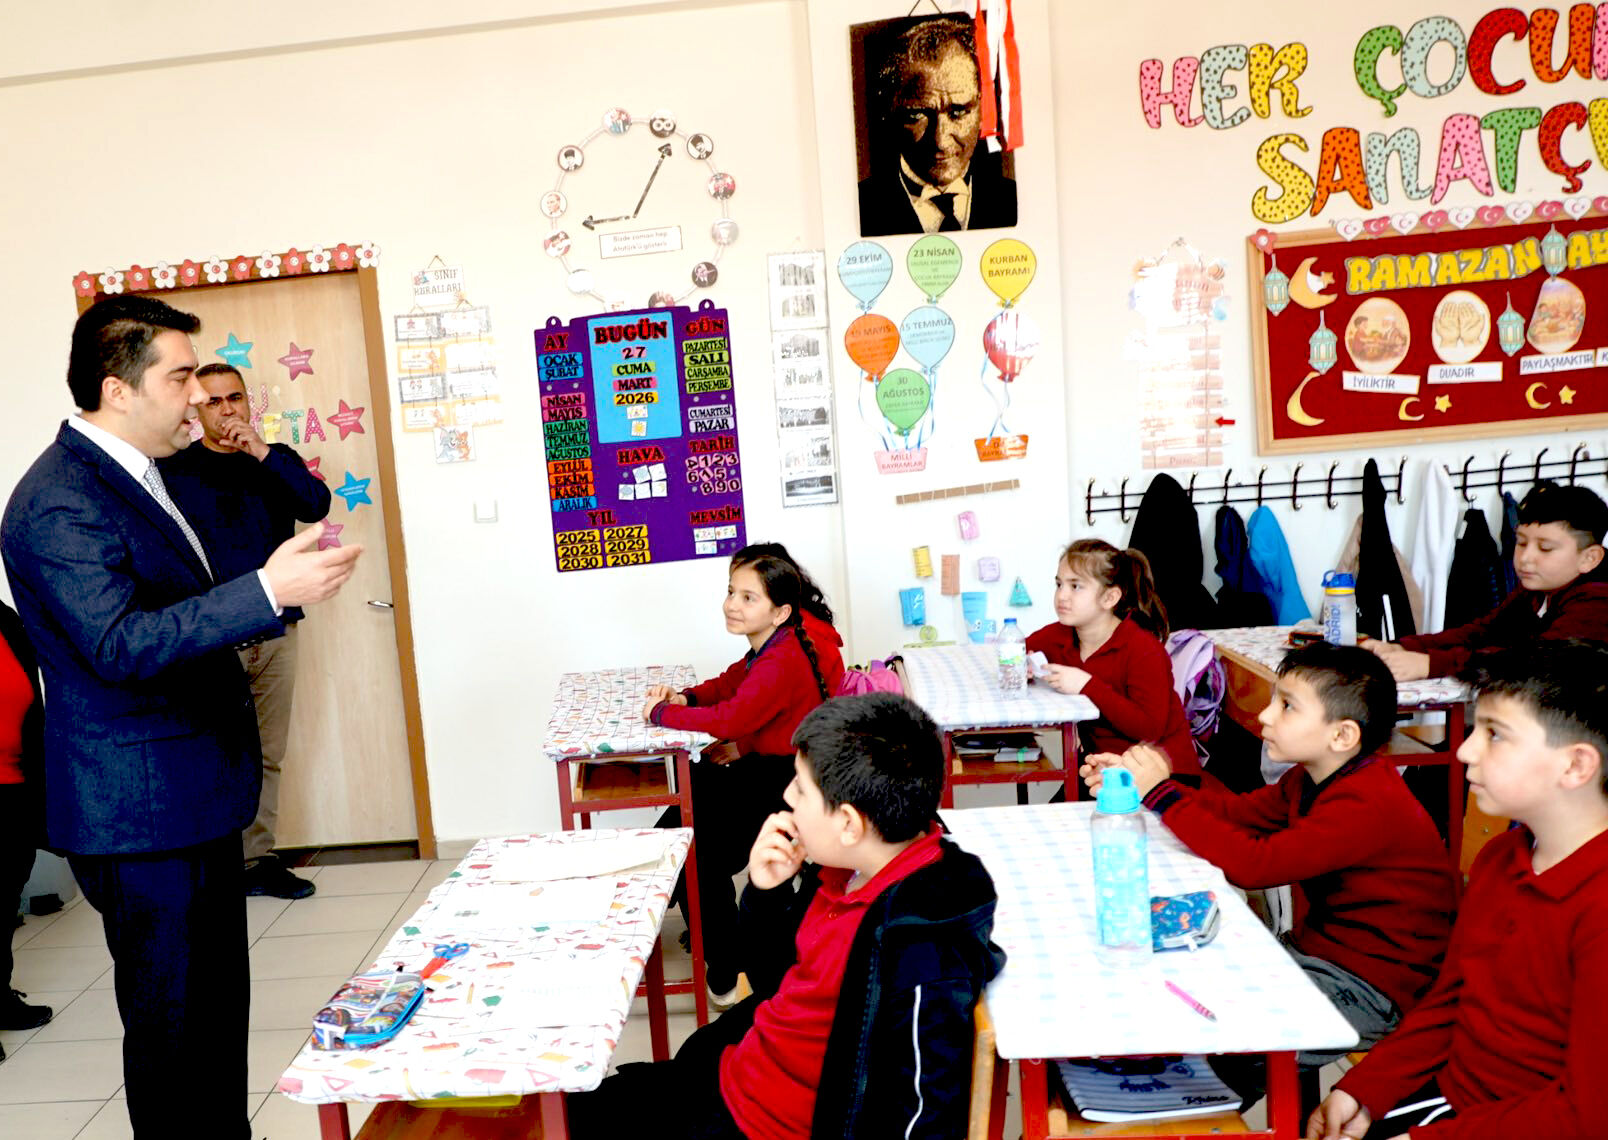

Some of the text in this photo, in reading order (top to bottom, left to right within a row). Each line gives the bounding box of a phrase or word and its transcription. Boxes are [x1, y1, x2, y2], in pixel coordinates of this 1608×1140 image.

[1139, 42, 1313, 130] HER
[914, 247, 955, 258] 23 NİSAN
[989, 254, 1028, 265] KURBAN
[846, 256, 857, 265] 29
[1344, 237, 1543, 294] RAMAZAN
[988, 268, 1030, 278] BAYRAMI
[685, 317, 725, 336] GÜN
[912, 317, 953, 330] TEMMUZ
[593, 318, 668, 344] BUGÜN
[544, 333, 569, 350] AY
[685, 337, 727, 353] PAZARTESİ
[544, 353, 579, 367] OCAK
[689, 353, 724, 365] SALI
[616, 362, 651, 376] CUMA
[1439, 366, 1475, 379] DUADIR
[617, 377, 653, 391] MART
[546, 394, 582, 407] NİSAN
[615, 391, 655, 405] 2026
[547, 406, 583, 420] MAYIS
[689, 404, 731, 418] CUMARTESİ
[694, 419, 729, 433] PAZAR
[546, 432, 589, 448] TEMMUZ
[689, 435, 735, 453] TARİH
[617, 446, 666, 464] HAVA
[713, 455, 724, 466] 2
[728, 453, 738, 465] 3
[554, 471, 589, 486] EKİM
[687, 471, 698, 482] 6
[715, 468, 725, 480] 5
[555, 484, 589, 498] KASIM
[702, 481, 713, 493] 8
[716, 480, 726, 492] 9
[559, 498, 593, 512] ARALIK
[586, 510, 616, 526] YIL
[689, 504, 741, 523] MEVSİM
[558, 526, 643, 544] 2025 2027
[561, 538, 646, 558] 2028 2029
[562, 552, 646, 570] 2030 2031
